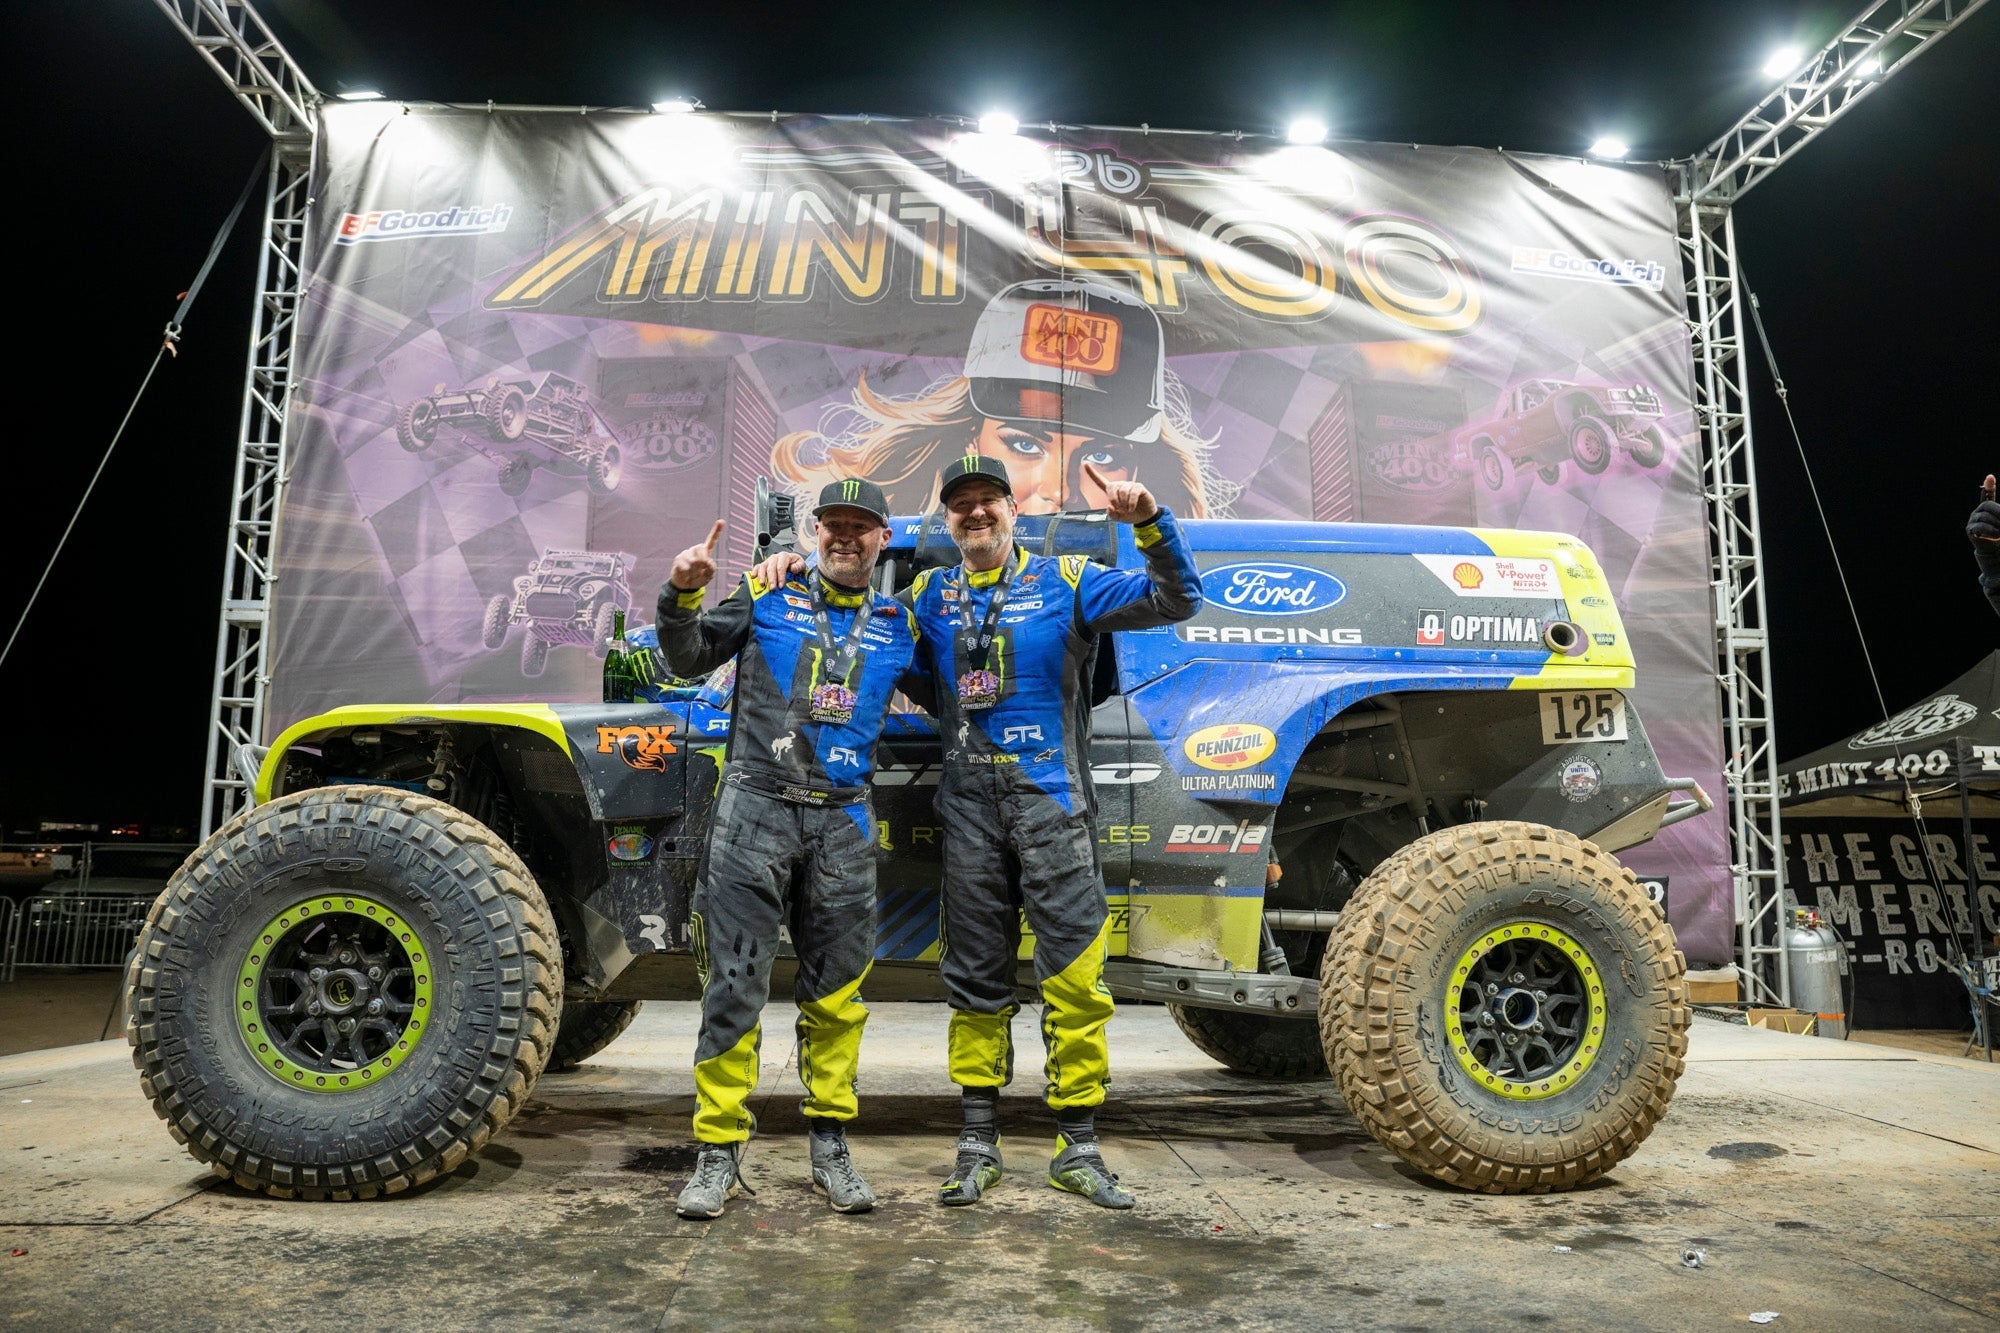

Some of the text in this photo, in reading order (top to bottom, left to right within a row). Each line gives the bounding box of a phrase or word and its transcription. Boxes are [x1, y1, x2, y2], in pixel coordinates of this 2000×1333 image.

[340, 203, 510, 237] BFGoodrich
[492, 182, 1483, 336] MINT 400
[1496, 562, 1514, 570] Shell
[1498, 569, 1546, 580] V-Power
[1224, 568, 1317, 607] Ford
[1002, 600, 1044, 612] RIGID
[1186, 626, 1362, 644] RACING
[1450, 614, 1539, 642] OPTIMA
[1550, 693, 1616, 740] 125
[595, 725, 677, 755] FOX
[1195, 732, 1264, 758] PENNZOIL
[1181, 774, 1275, 791] ULTRA PLATINUM
[1795, 760, 1872, 795] MINT
[1873, 749, 1951, 780] 400
[613, 824, 647, 838] DYNAMIC
